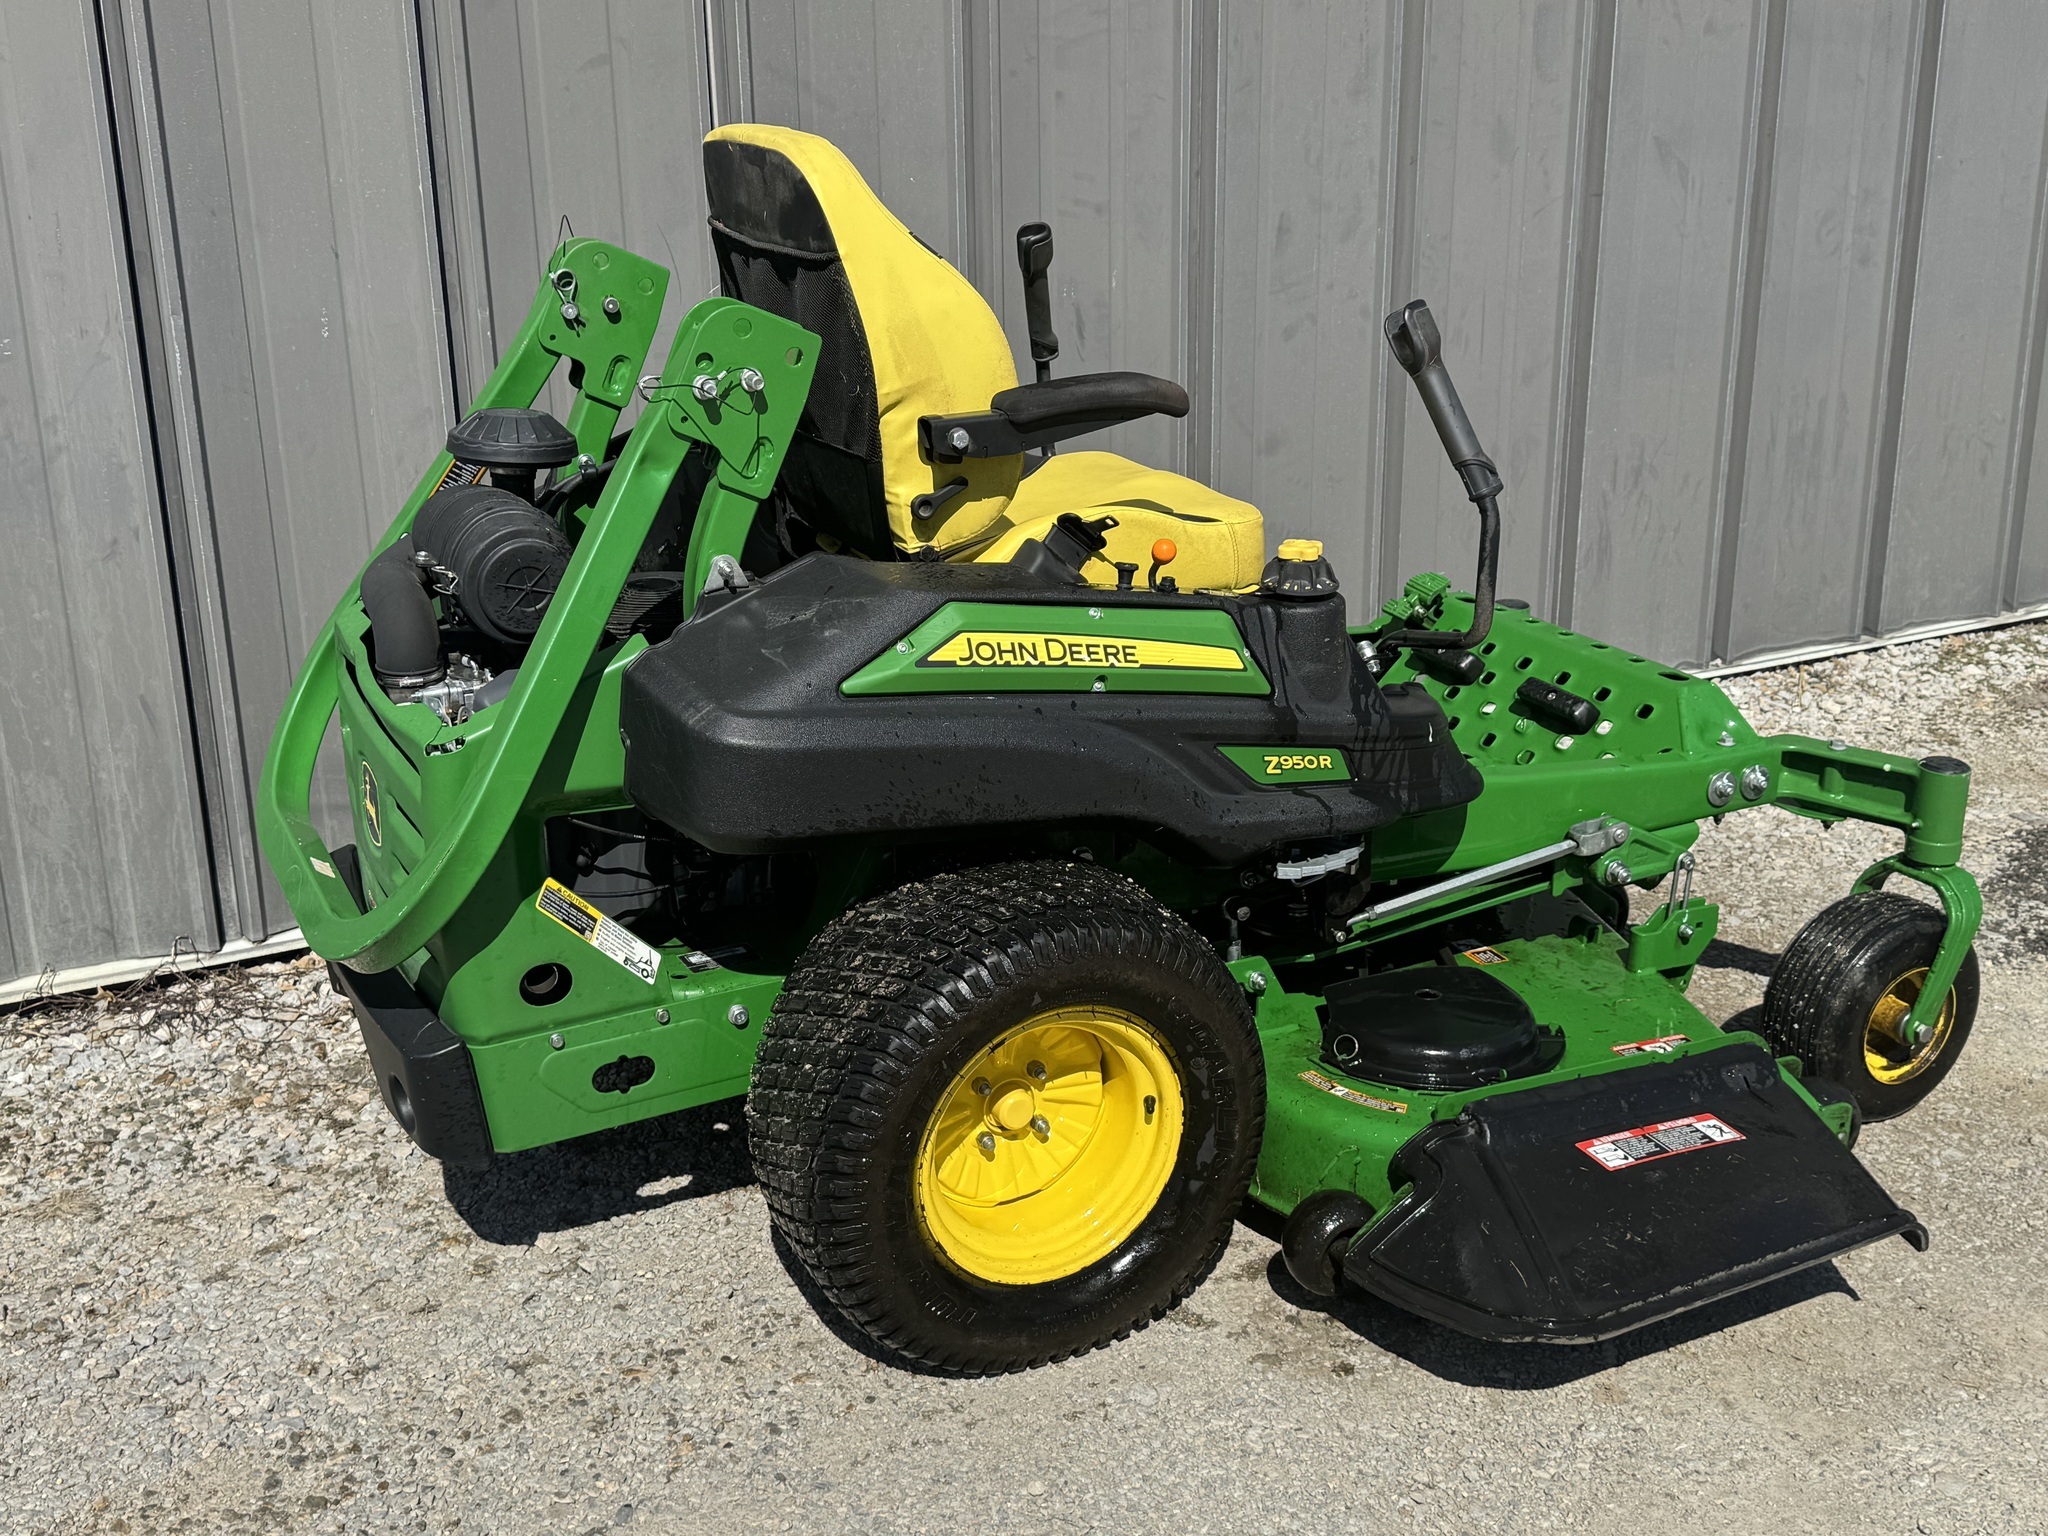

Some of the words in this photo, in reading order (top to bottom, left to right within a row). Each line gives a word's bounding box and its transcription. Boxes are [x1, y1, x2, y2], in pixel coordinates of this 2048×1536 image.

[958, 637, 1039, 662] JOHN
[1044, 638, 1140, 664] DEERE
[1263, 755, 1333, 774] Z950R
[562, 889, 590, 911] CAUTION
[1180, 1022, 1239, 1236] CARLISLE
